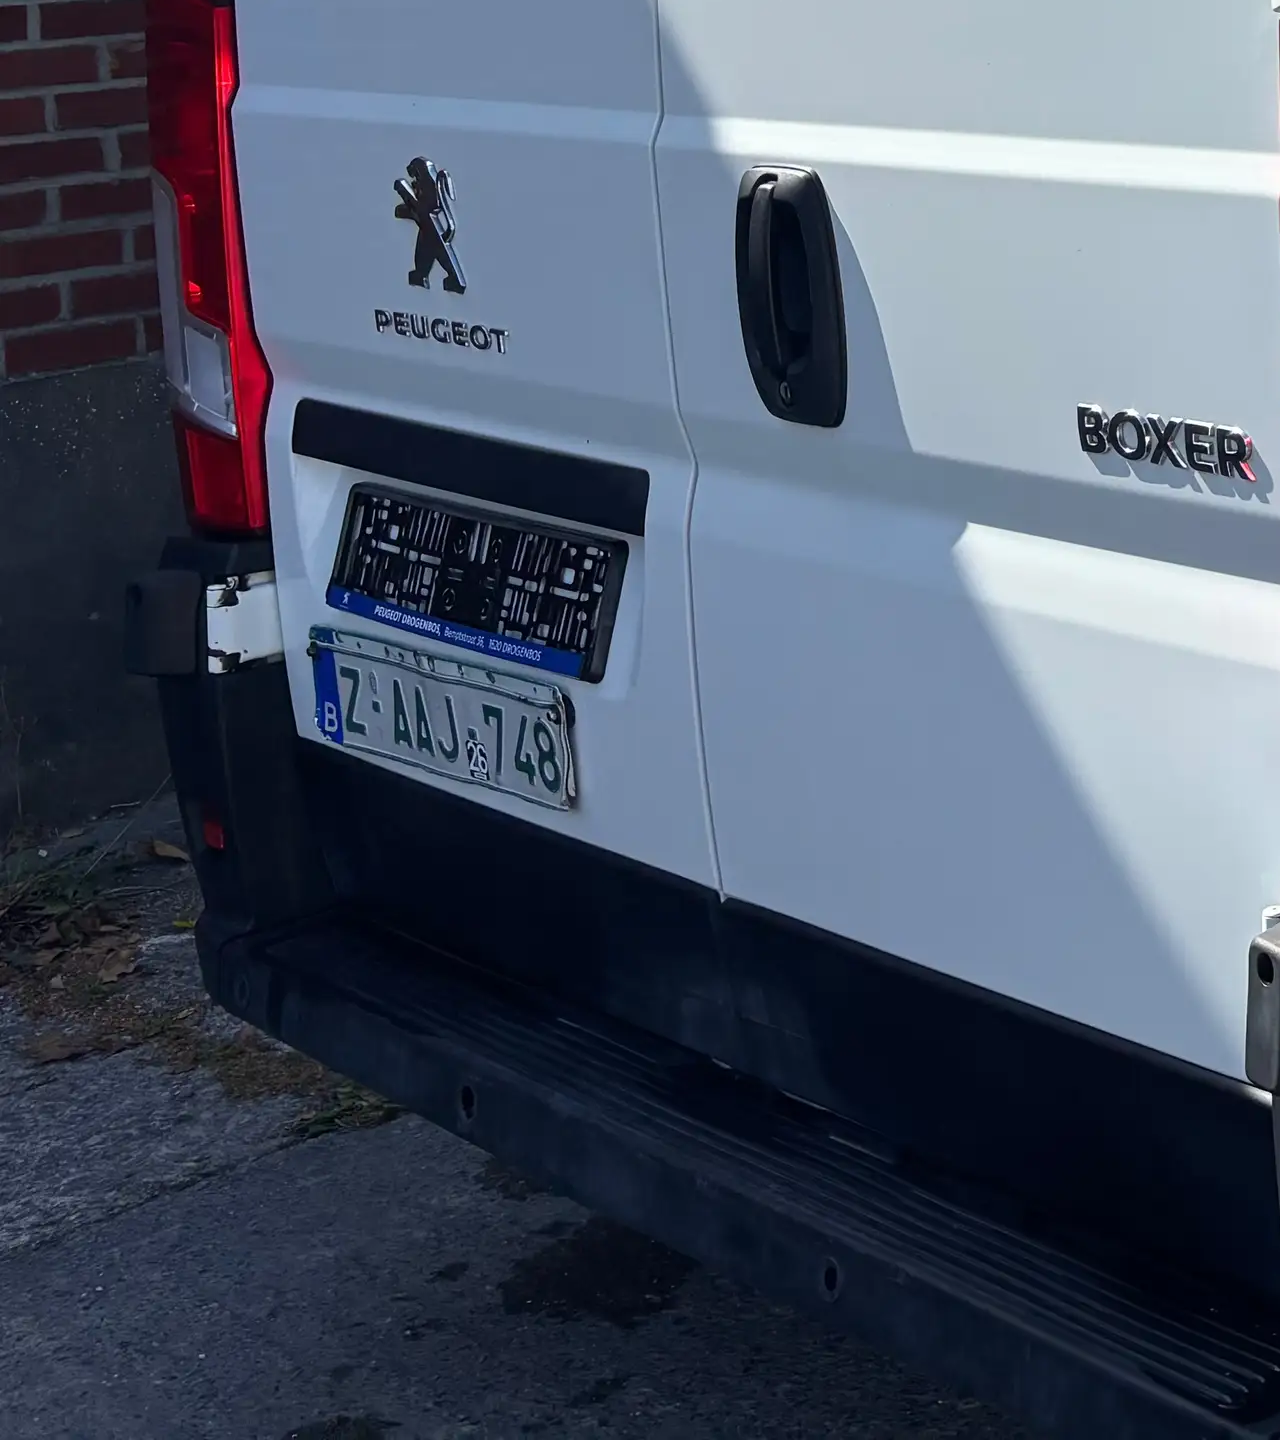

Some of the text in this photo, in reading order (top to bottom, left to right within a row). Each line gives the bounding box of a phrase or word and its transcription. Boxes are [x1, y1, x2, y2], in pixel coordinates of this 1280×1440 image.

[374, 309, 510, 355] PEUGEOT
[1076, 401, 1257, 482] BOXER
[374, 604, 402, 622] PEUGEOT
[324, 702, 338, 733] B
